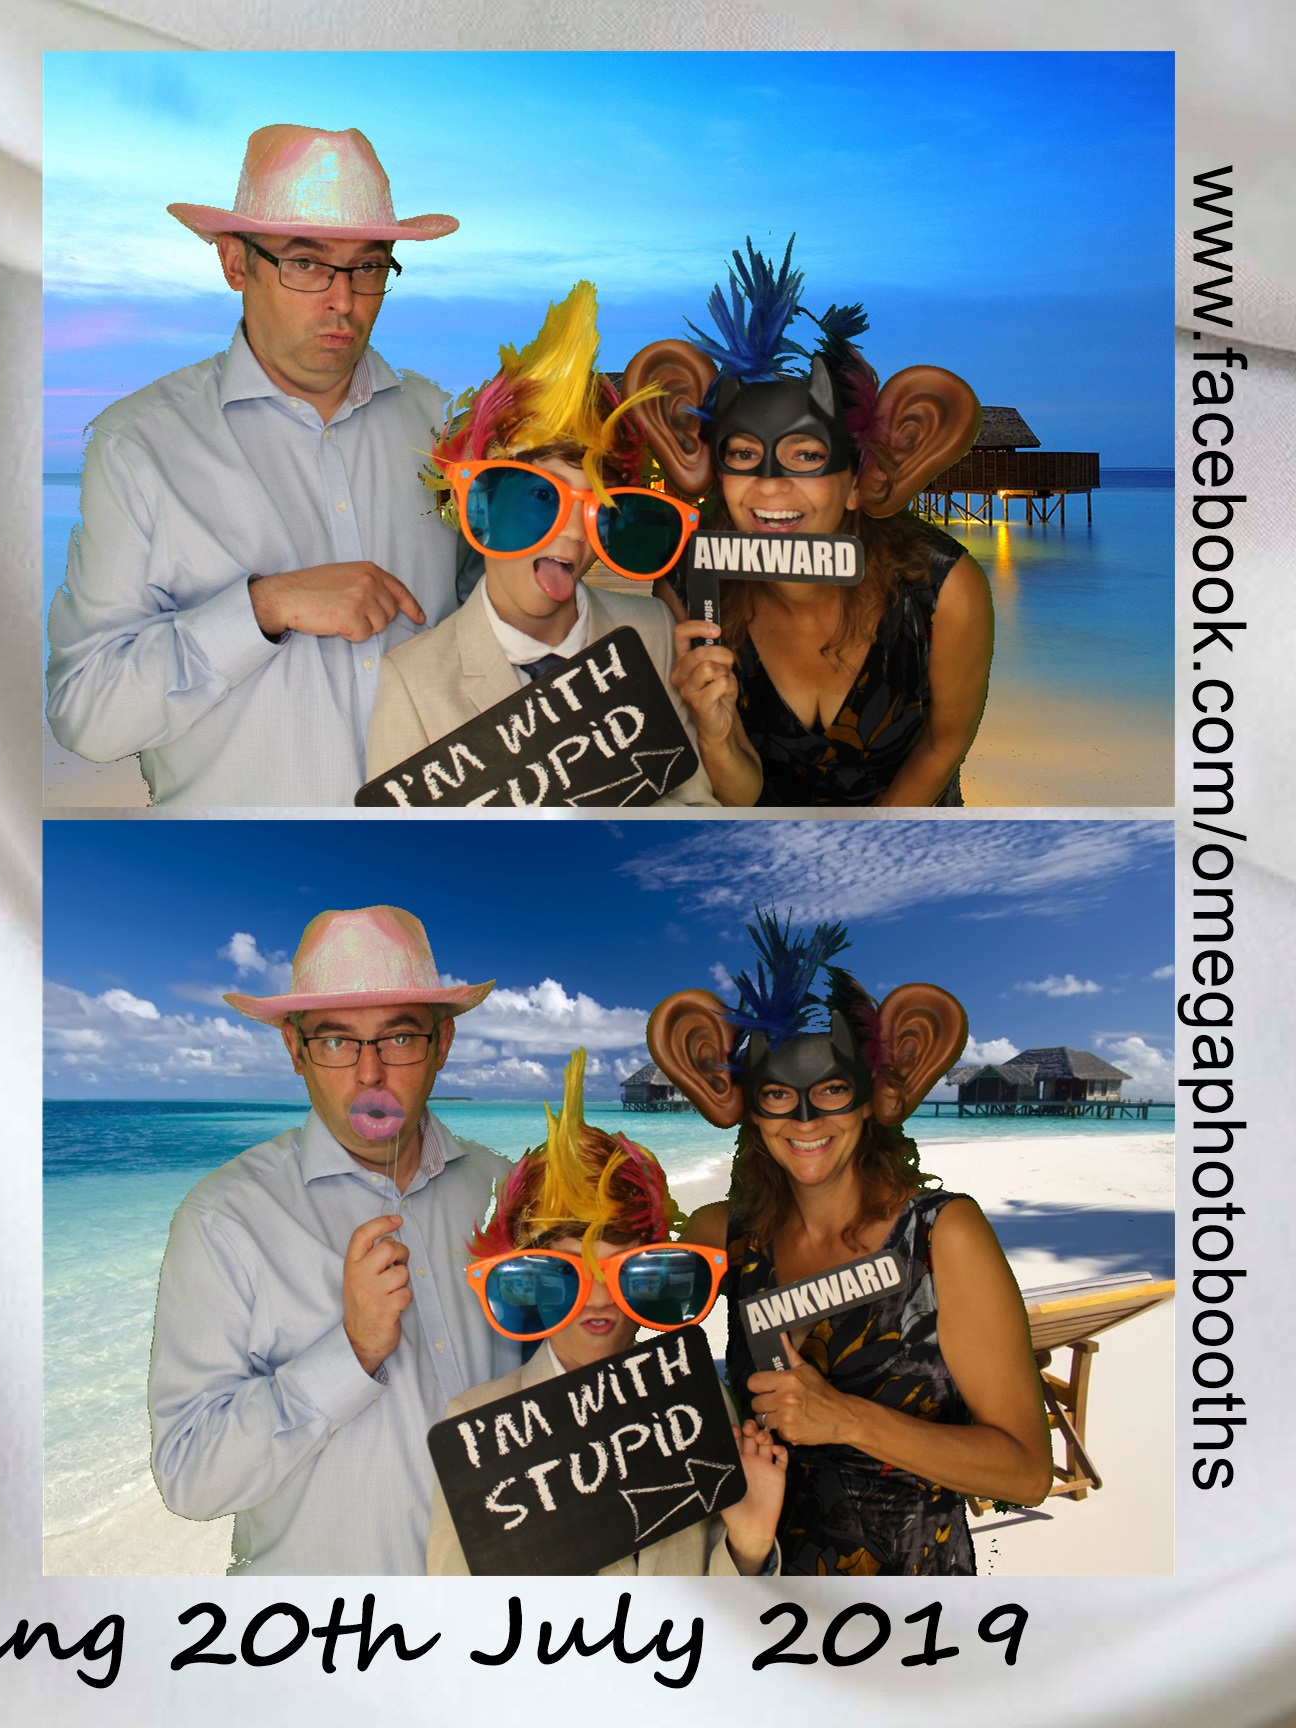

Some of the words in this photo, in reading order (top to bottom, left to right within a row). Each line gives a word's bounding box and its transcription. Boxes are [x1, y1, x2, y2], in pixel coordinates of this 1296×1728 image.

[693, 536, 857, 578] AWKWARD
[384, 743, 486, 807] I'M
[746, 1255, 902, 1335] AWKWARD
[457, 1400, 553, 1468] I'M
